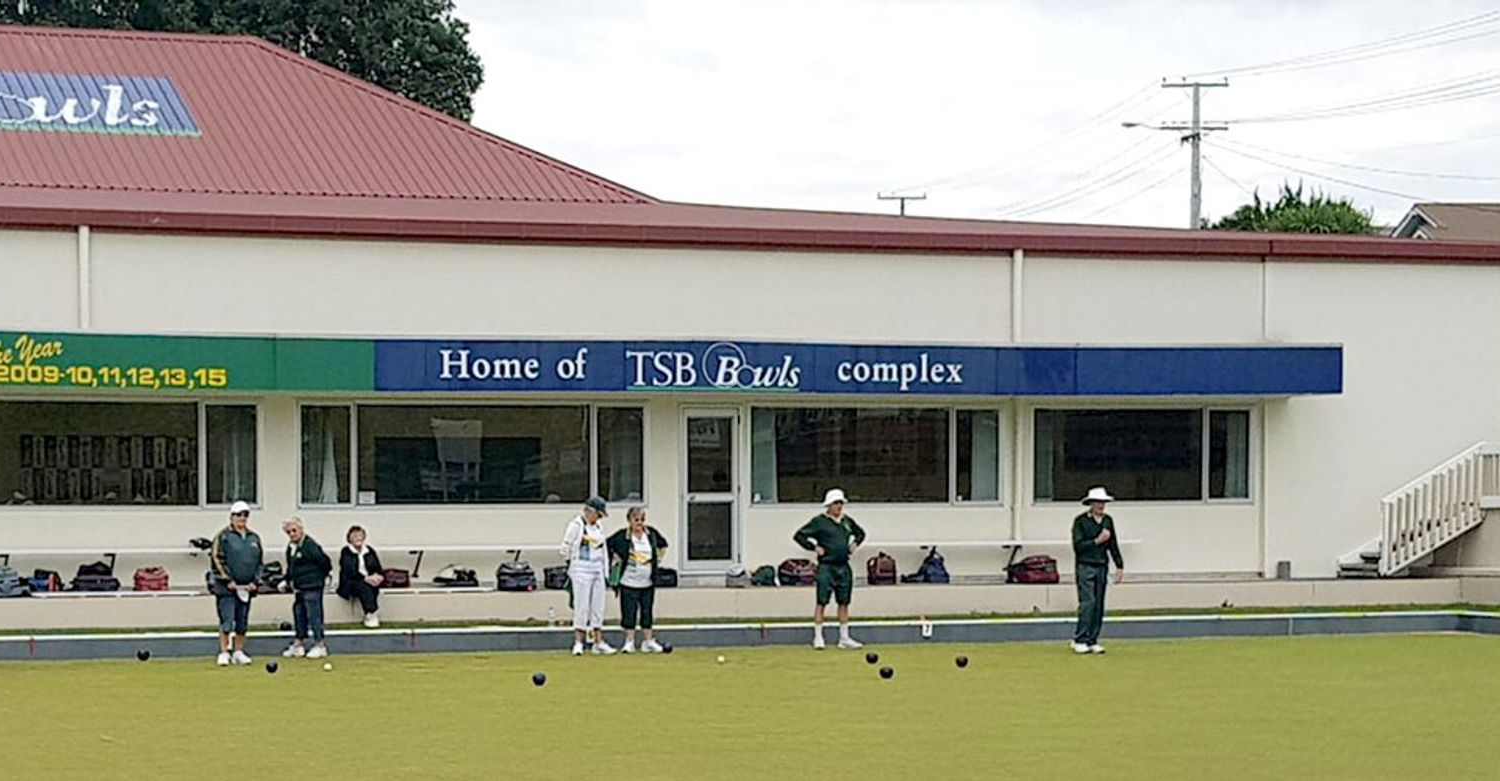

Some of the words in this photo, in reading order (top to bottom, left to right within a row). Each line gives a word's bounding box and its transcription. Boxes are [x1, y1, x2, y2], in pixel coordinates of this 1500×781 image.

[14, 334, 65, 367] Year
[439, 350, 540, 381] Home
[556, 348, 588, 381] of
[626, 350, 697, 387] TSB
[715, 355, 801, 388] Bowls
[837, 353, 963, 391] complex
